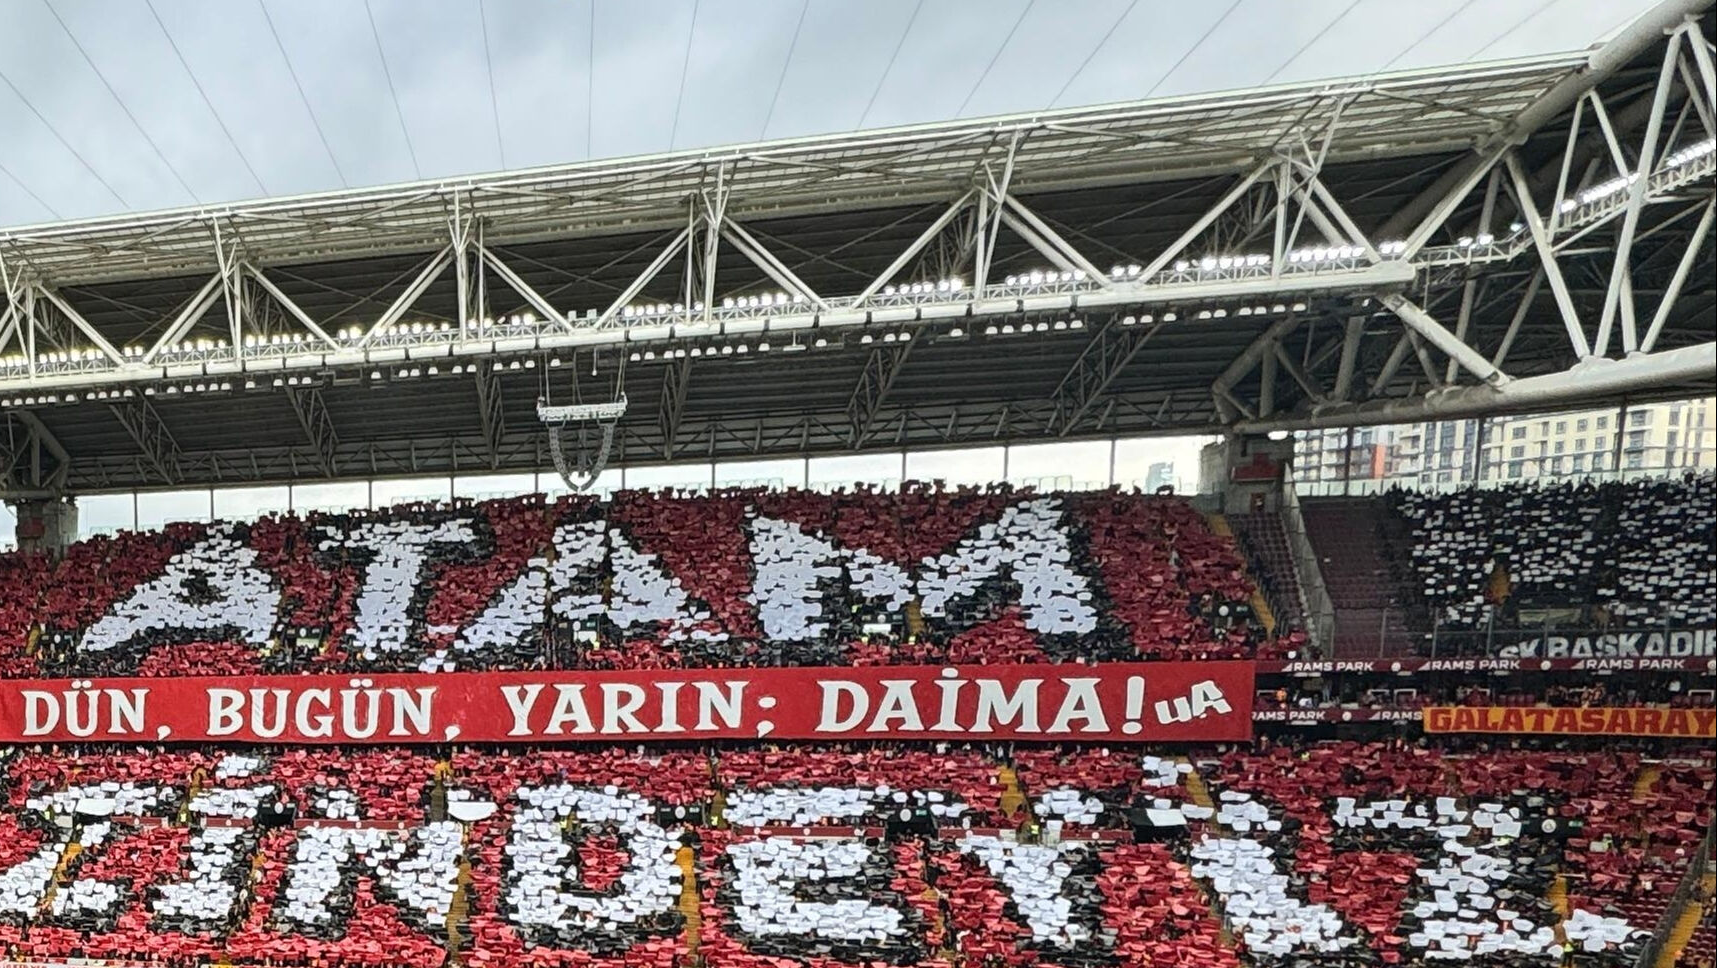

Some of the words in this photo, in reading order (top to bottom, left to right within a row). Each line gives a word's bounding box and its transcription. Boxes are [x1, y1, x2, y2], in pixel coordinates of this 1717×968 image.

[80, 498, 1098, 664] ATAM
[1294, 661, 1334, 672] RAMS
[1337, 661, 1374, 672] PARK
[1432, 660, 1474, 671] RAMS
[1479, 659, 1521, 670] PARK
[1587, 659, 1634, 669] RAMS
[1639, 659, 1686, 669] PARK
[20, 680, 172, 741] DÜN,
[205, 678, 461, 742] BUGÜN,
[499, 681, 777, 738] YARIN;
[815, 669, 1145, 736] DAİMA!
[1289, 711, 1325, 721] PARK
[1382, 711, 1422, 721] RAMS
[1428, 709, 1716, 735] GALATASARAY
